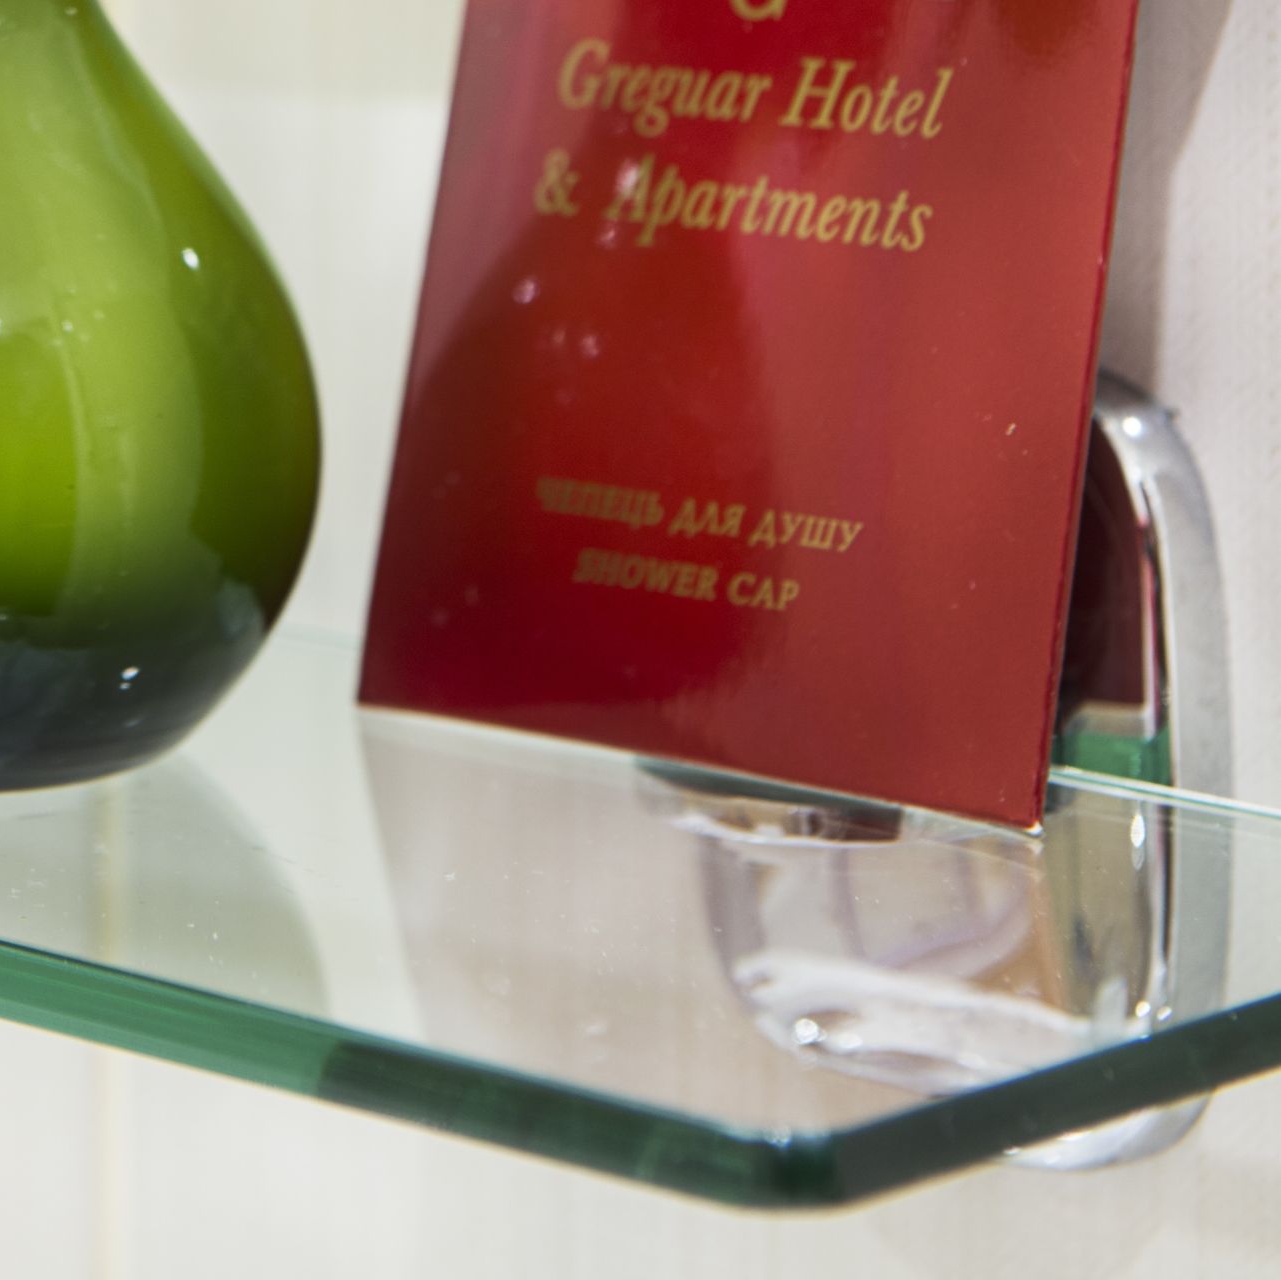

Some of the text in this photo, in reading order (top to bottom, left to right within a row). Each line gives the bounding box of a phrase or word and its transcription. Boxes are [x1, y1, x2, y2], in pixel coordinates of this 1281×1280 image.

[558, 37, 953, 138] Greguar Hotel
[533, 148, 933, 251] & Apartments
[668, 497, 746, 538] ДЛЯ
[748, 510, 863, 552] ДУШУ
[572, 547, 799, 611] SHOWER CAP
